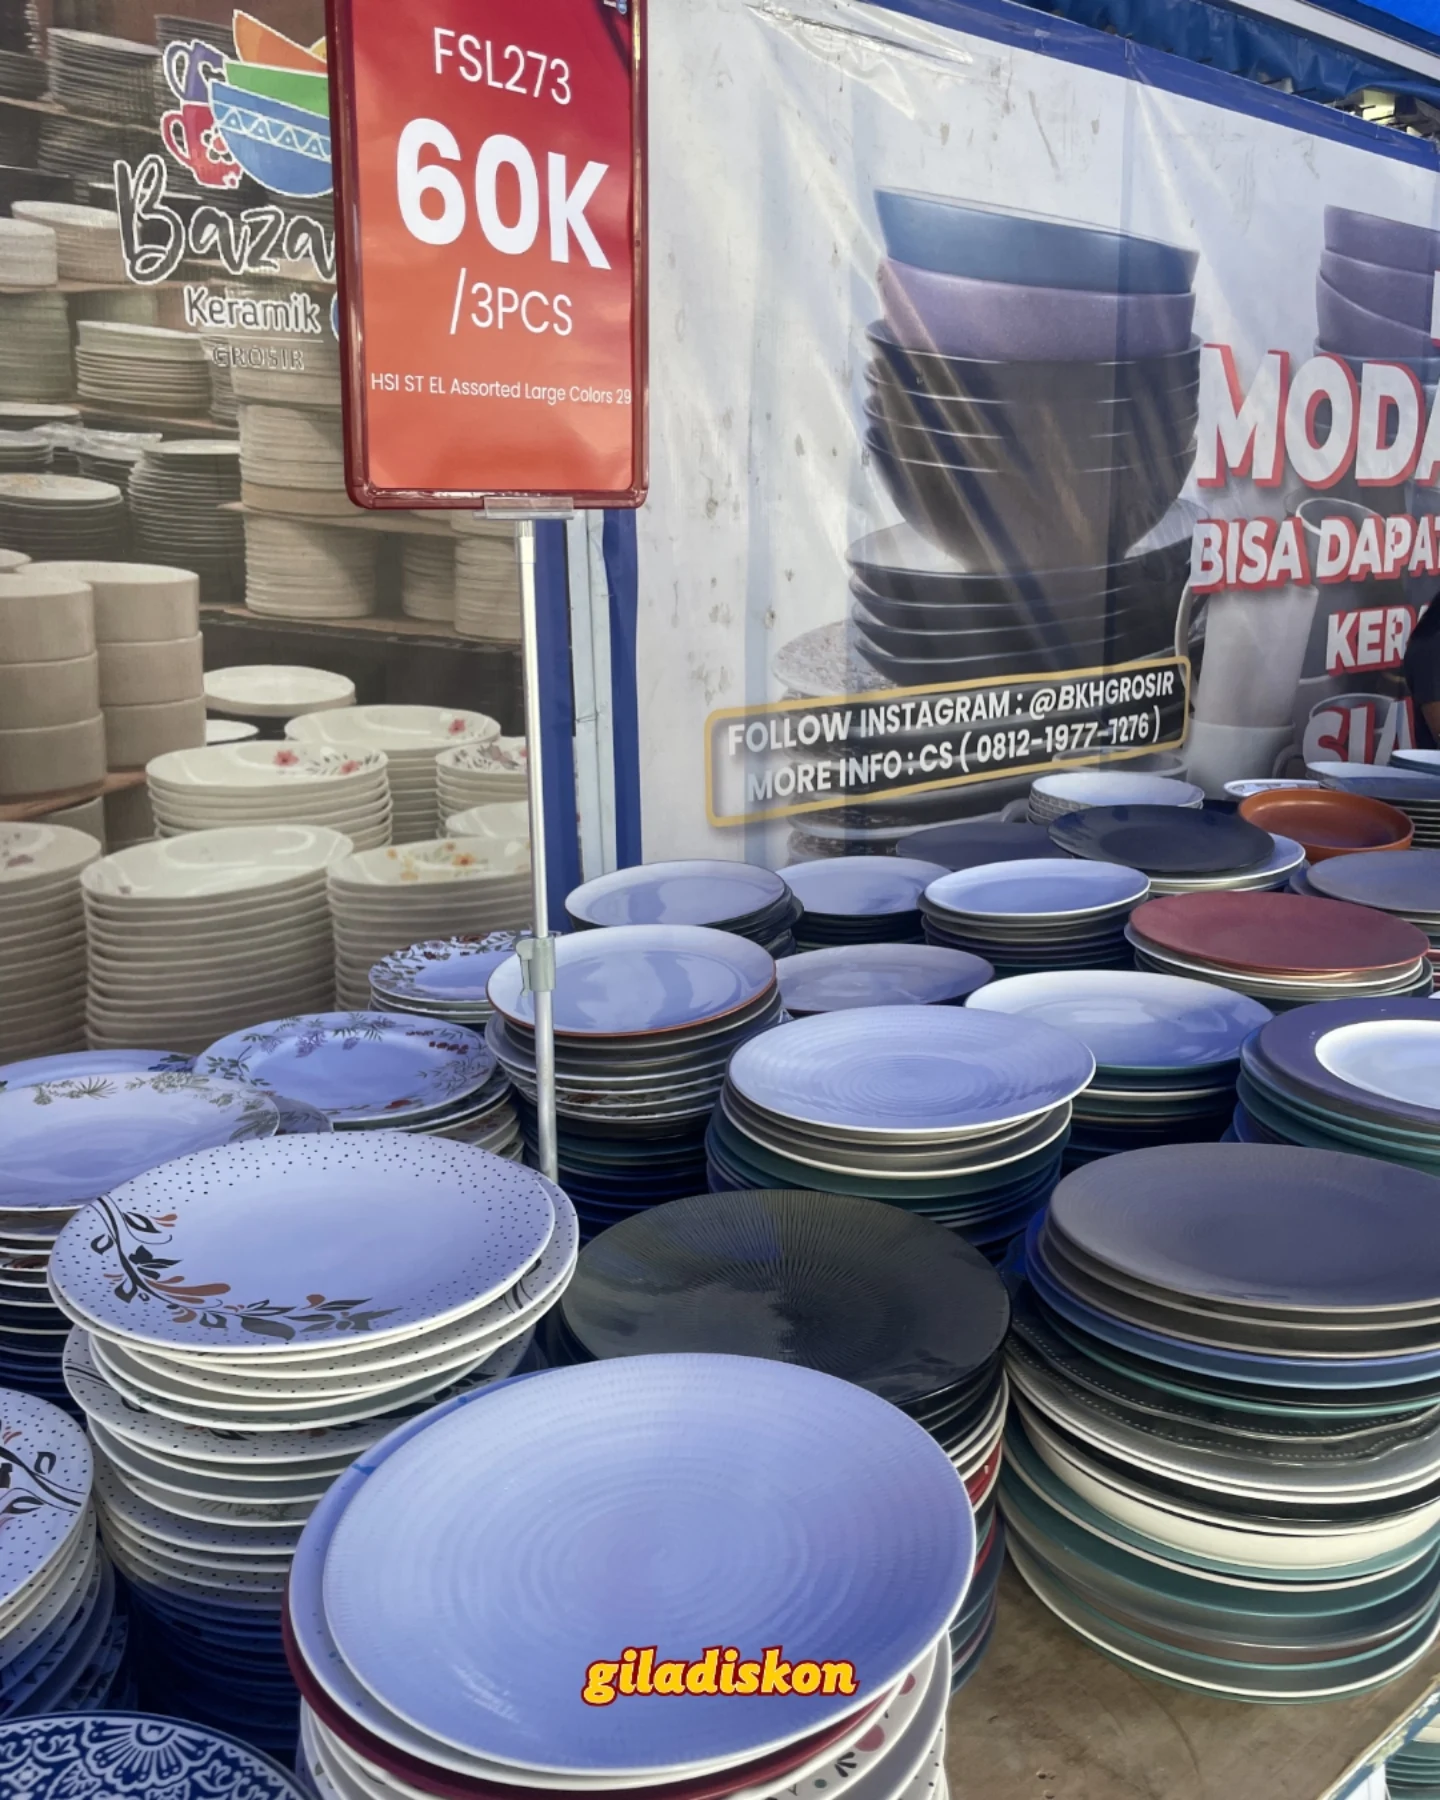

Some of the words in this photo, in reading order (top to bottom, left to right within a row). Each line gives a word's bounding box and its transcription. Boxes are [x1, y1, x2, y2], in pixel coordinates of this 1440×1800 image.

[434, 27, 571, 105] FSL273
[397, 118, 612, 270] 60K
[183, 285, 322, 333] Keramik
[450, 267, 573, 336] /3PCS
[212, 345, 304, 370] GROSIR
[371, 372, 399, 391] HSI
[404, 375, 424, 392] ST
[429, 376, 446, 394] EL
[450, 378, 521, 398] Assorted
[525, 383, 565, 404] Large
[569, 386, 613, 404] Colors
[616, 388, 632, 405] 29
[1188, 517, 1309, 593] BISA
[1316, 514, 1440, 584] DAPA
[1326, 603, 1430, 676] KER
[728, 711, 852, 756] FOLLOW
[860, 691, 1010, 738] INSTAGRAM
[1029, 670, 1174, 720] @BKHGROSIR
[748, 760, 831, 801] MORE
[839, 750, 902, 787] INFO
[919, 741, 953, 772] CS
